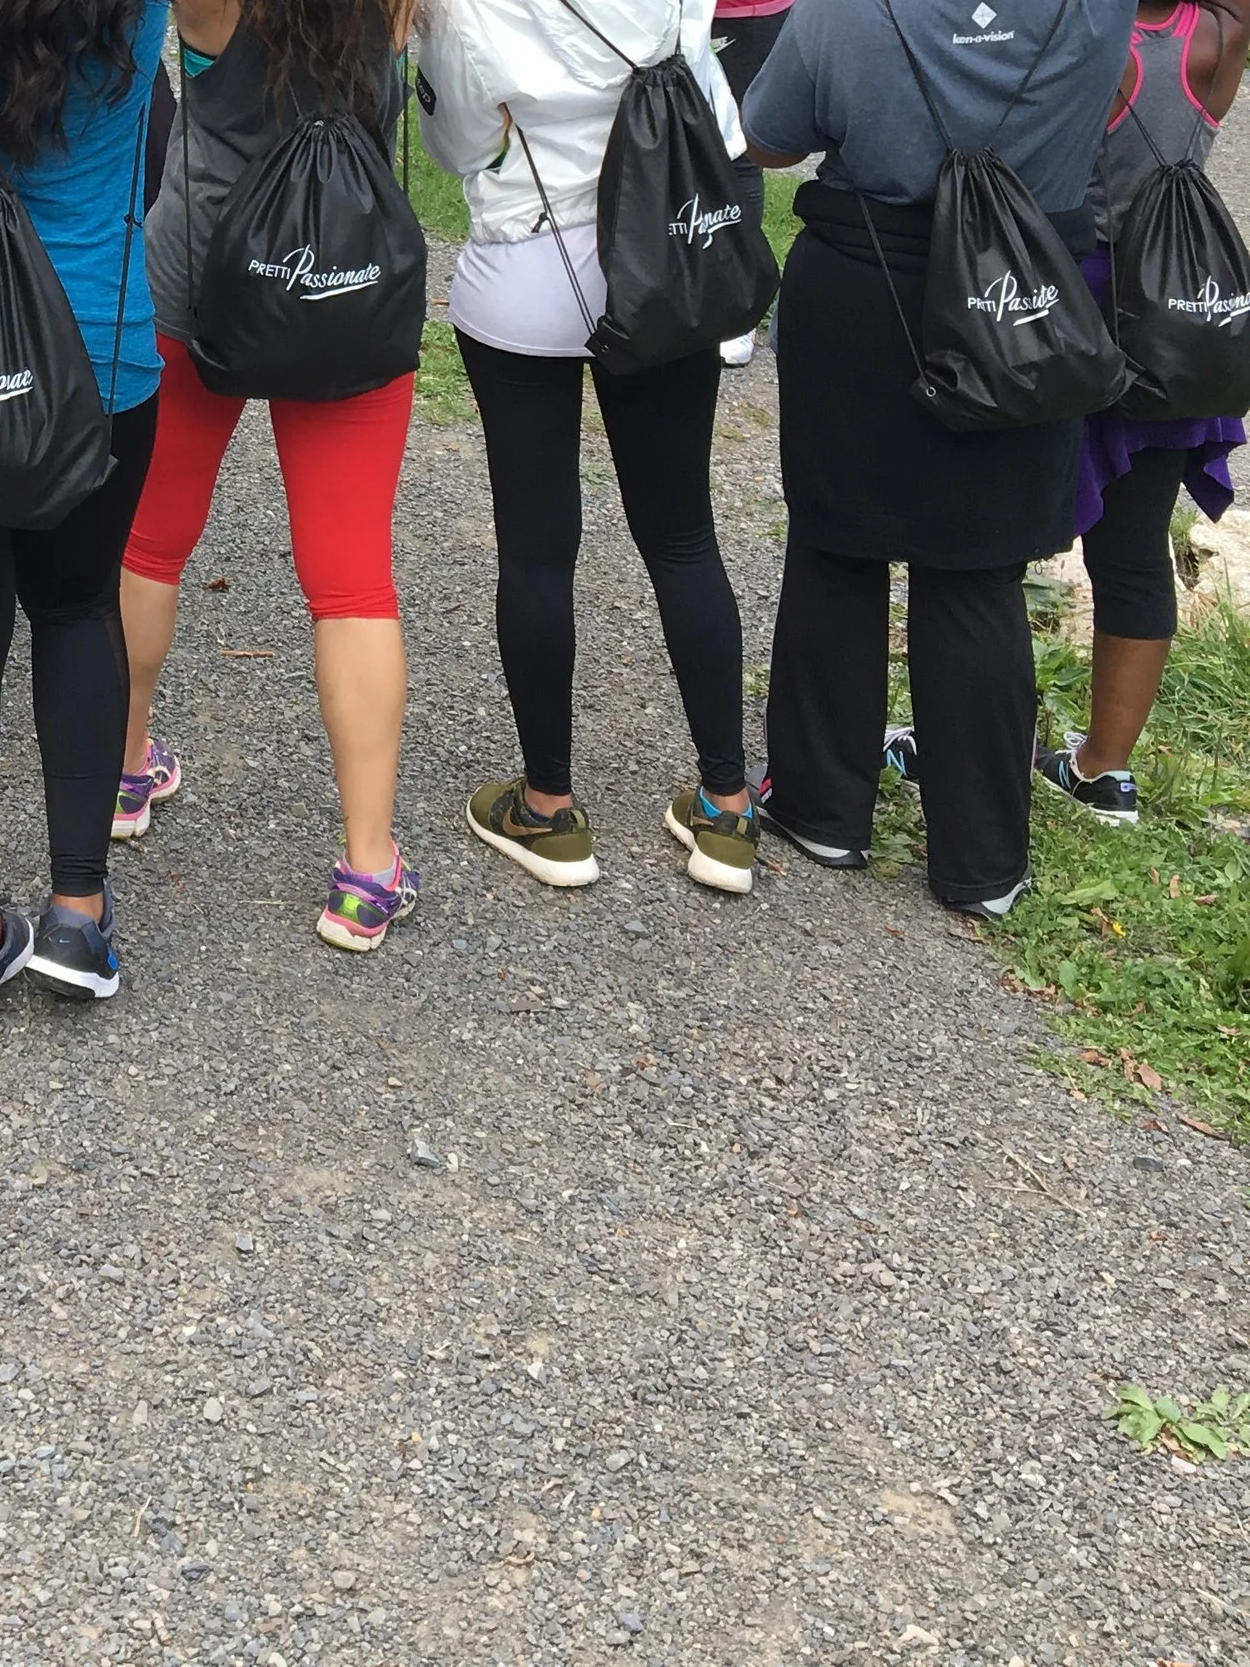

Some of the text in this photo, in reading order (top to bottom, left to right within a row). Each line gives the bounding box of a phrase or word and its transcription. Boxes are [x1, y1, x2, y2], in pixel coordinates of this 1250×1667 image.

[952, 30, 1014, 45] ken-a-vision
[248, 244, 382, 291] PRETTI Passionate
[1167, 298, 1208, 313] PRETTI
